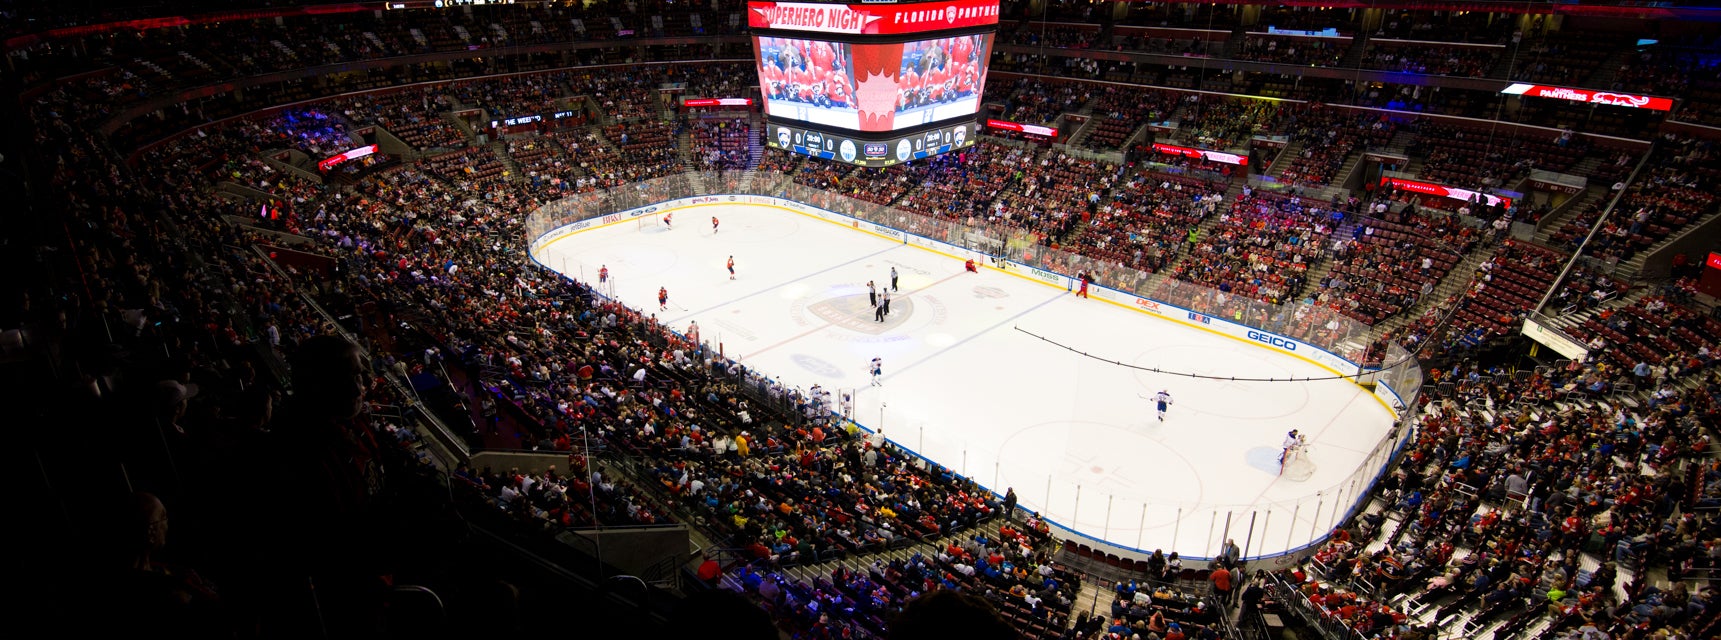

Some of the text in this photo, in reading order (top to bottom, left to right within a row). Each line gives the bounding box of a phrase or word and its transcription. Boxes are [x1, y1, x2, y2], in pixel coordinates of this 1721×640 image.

[762, 6, 870, 30] SUPERHERO NIGHT
[894, 9, 944, 24] FLORIDA
[1540, 90, 1587, 101] PANTHERS
[795, 132, 801, 144] 0
[945, 132, 951, 143] 0
[827, 139, 833, 150] 0
[916, 139, 922, 150] 0
[1135, 297, 1161, 309] DEX
[1247, 330, 1297, 351] GEICO
